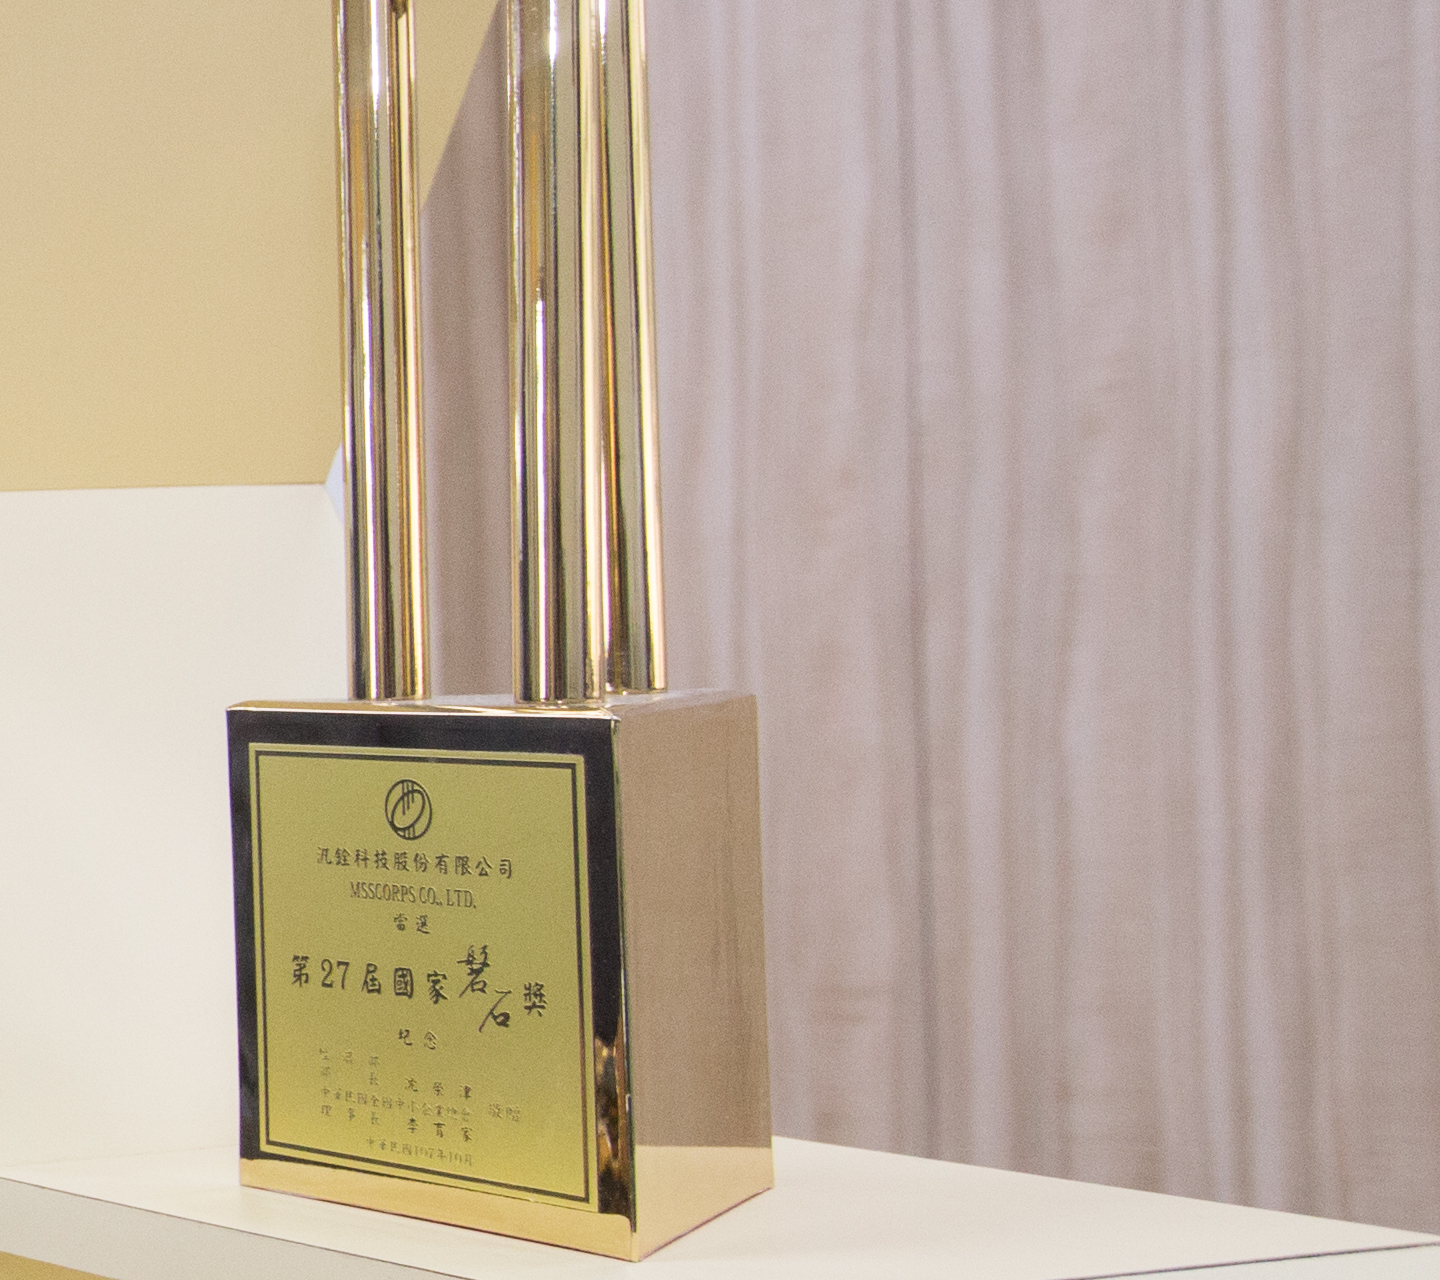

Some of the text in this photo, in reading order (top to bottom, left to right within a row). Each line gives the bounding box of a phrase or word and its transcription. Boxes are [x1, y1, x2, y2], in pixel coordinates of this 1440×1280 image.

[317, 846, 513, 880] 汎銓科技股份有限公司
[350, 881, 416, 904] MSSCORPS
[393, 913, 431, 935] 當選
[397, 1028, 437, 1050] 紀念
